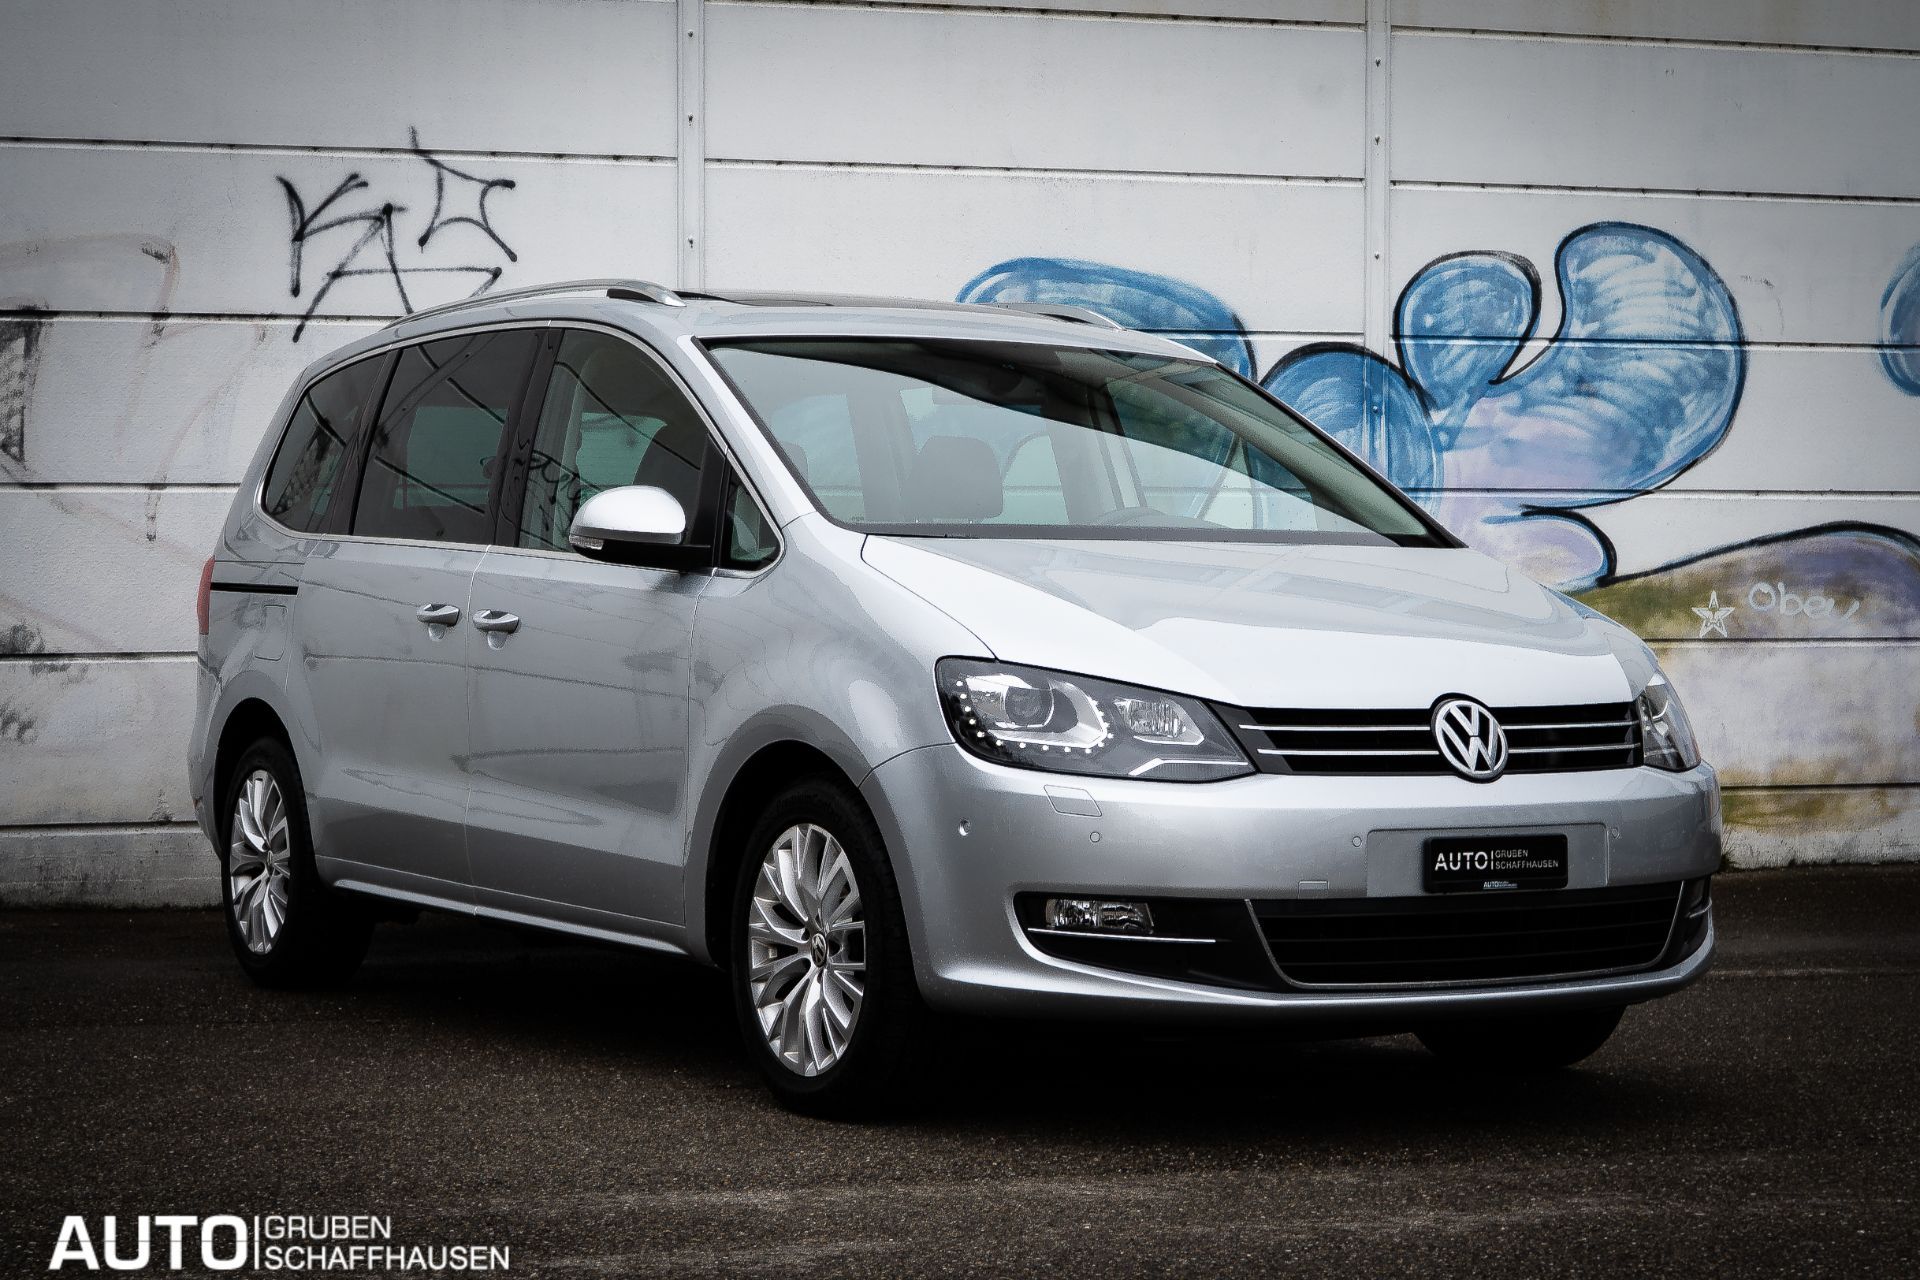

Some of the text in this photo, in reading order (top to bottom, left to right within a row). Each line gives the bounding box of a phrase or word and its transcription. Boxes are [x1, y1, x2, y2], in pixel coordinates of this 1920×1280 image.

[1495, 849, 1529, 858] GRUBEN
[1434, 851, 1488, 871] AUTO
[1495, 859, 1559, 870] SCHAFFHAUSEN
